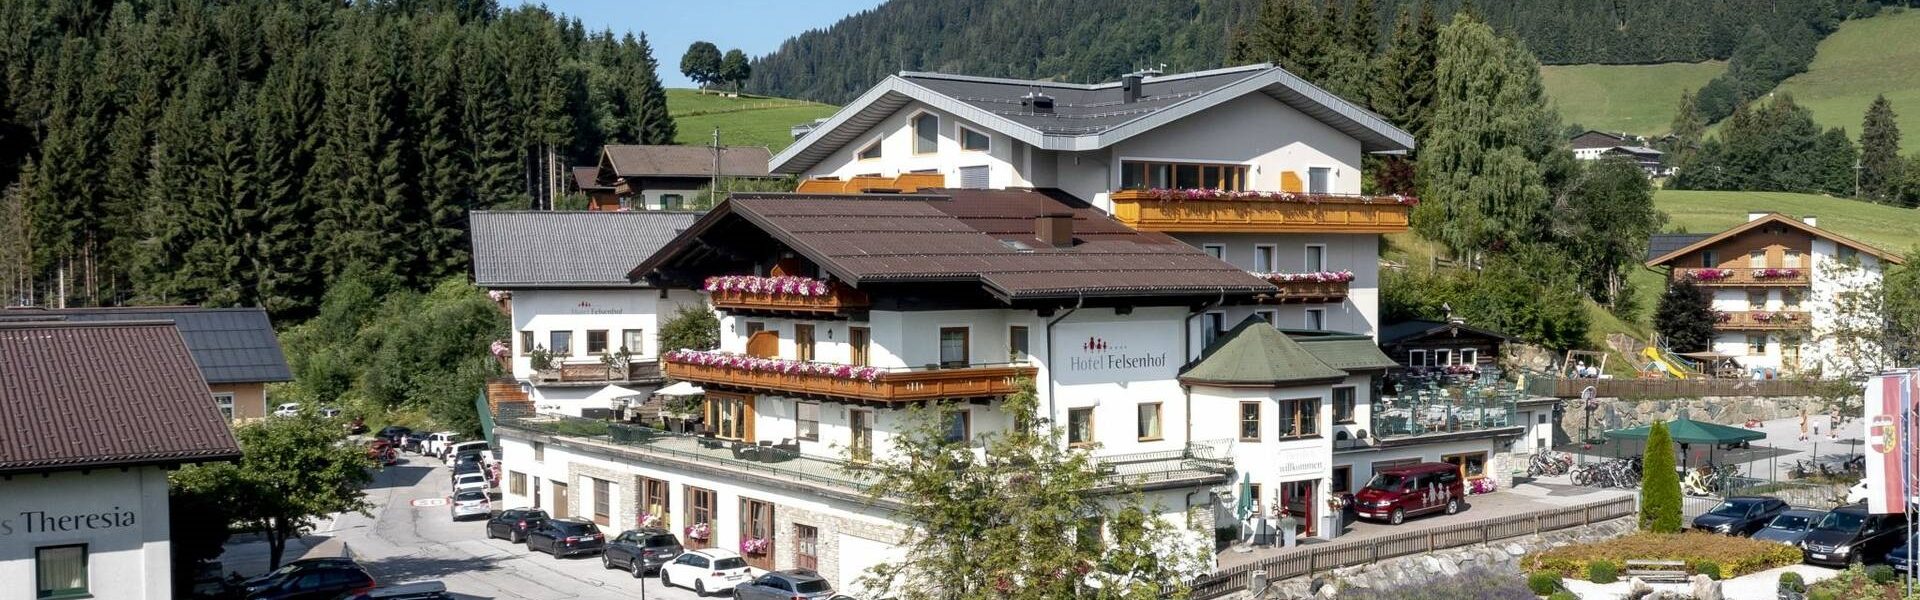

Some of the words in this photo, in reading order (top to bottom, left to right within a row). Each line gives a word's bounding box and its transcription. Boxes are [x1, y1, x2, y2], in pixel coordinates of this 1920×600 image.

[1070, 354, 1104, 372] Hotel
[1108, 351, 1167, 370] Felsenhof
[20, 506, 136, 533] Theresia
